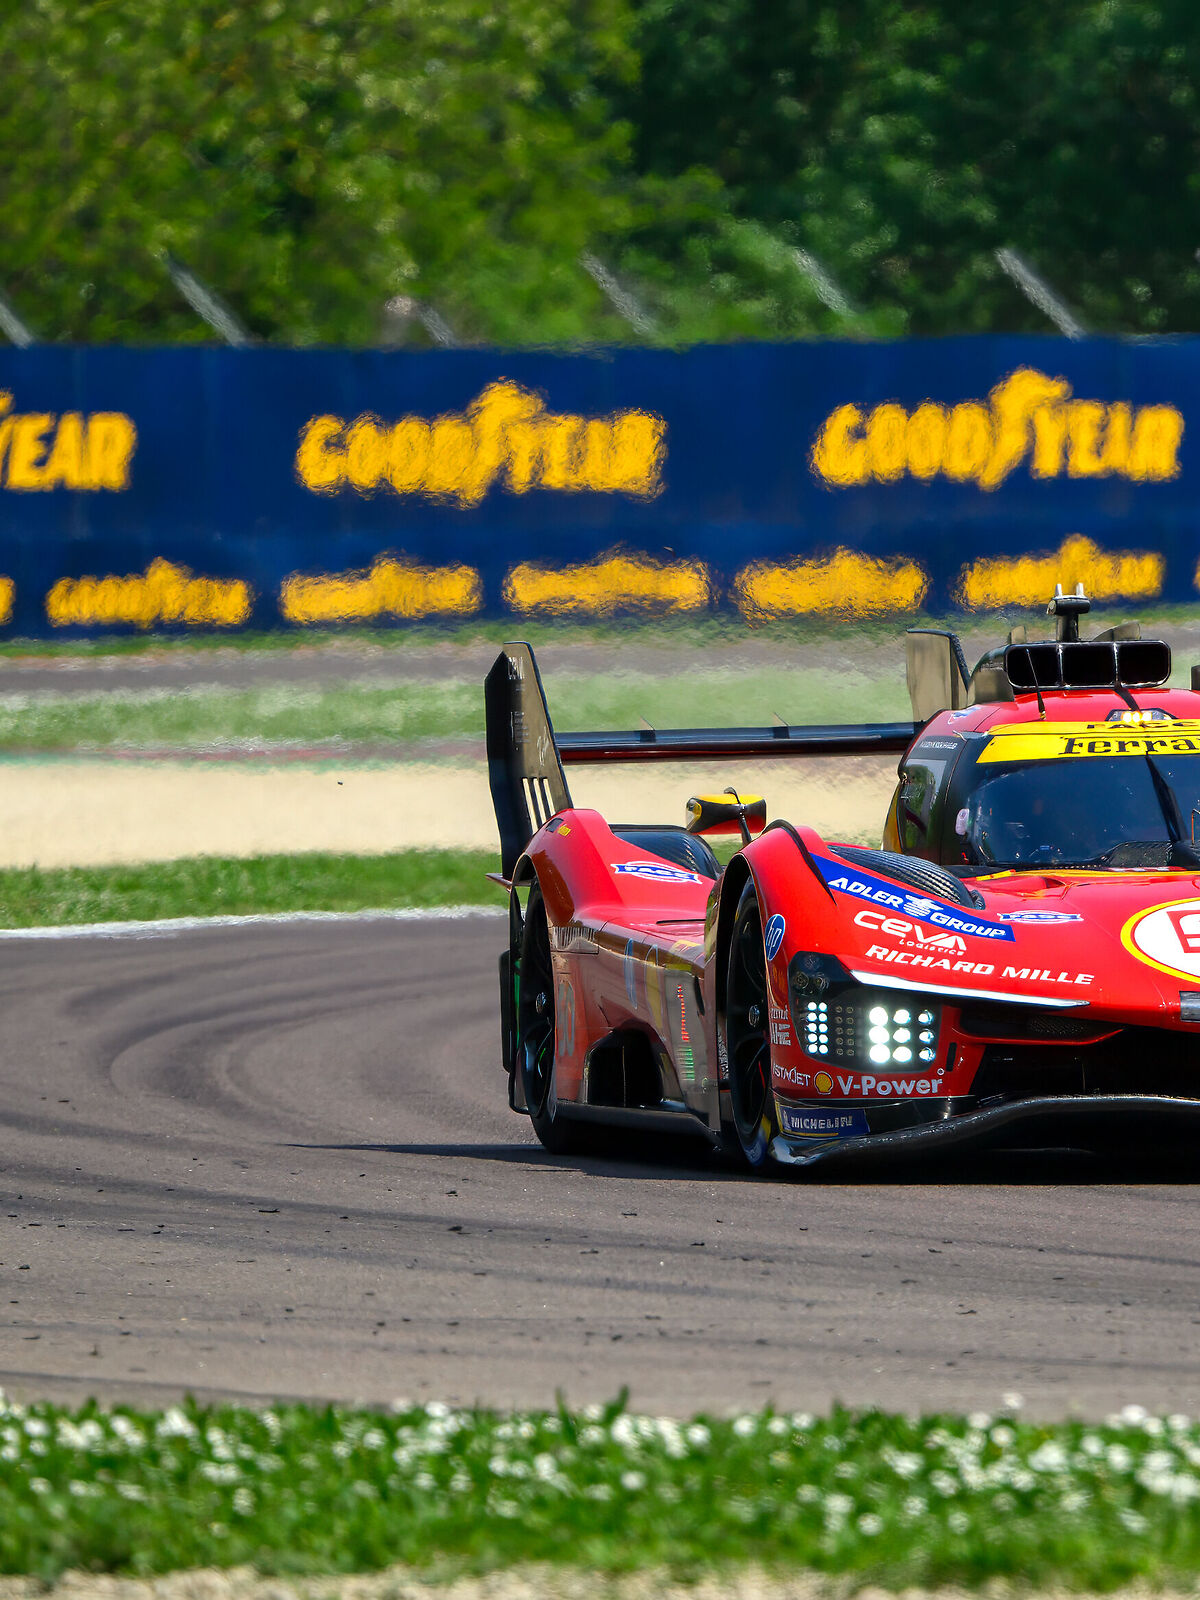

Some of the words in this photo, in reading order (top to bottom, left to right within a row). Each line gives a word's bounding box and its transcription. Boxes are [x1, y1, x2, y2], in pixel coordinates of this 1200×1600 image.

[827, 876, 905, 909] ADLER
[929, 911, 1007, 938] GROUP
[864, 944, 995, 976] RICHARD
[1001, 965, 1095, 986] MILLE
[836, 1075, 944, 1096] V-Power
